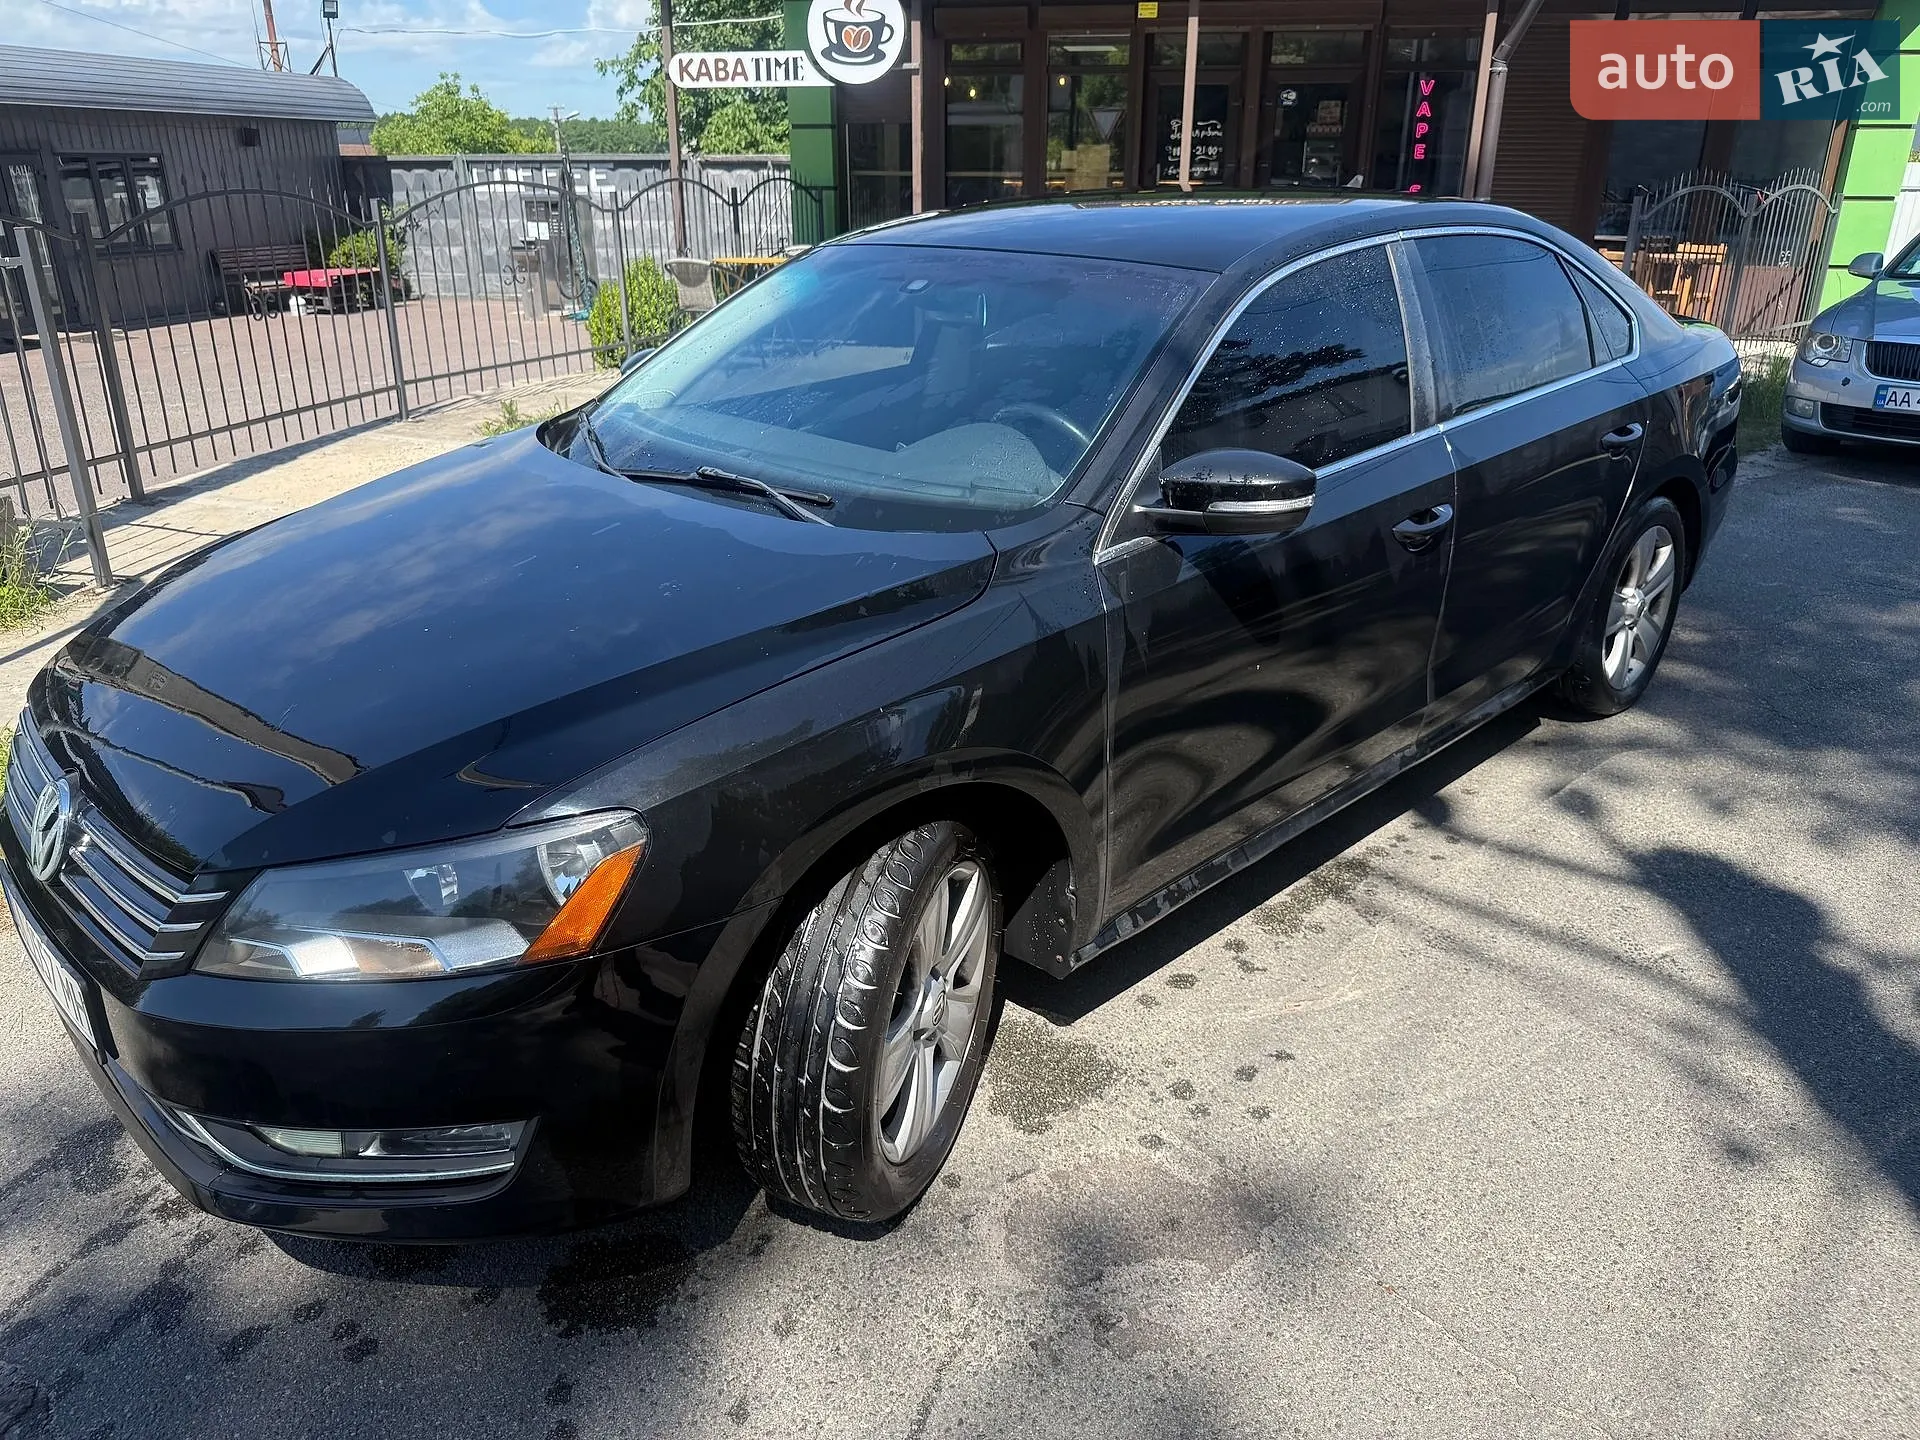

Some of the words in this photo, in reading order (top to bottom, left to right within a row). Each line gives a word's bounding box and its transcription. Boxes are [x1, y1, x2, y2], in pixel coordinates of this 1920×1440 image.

[751, 55, 804, 82] TIME
[1414, 80, 1435, 159] VAPE
[1886, 391, 1910, 407] AA
